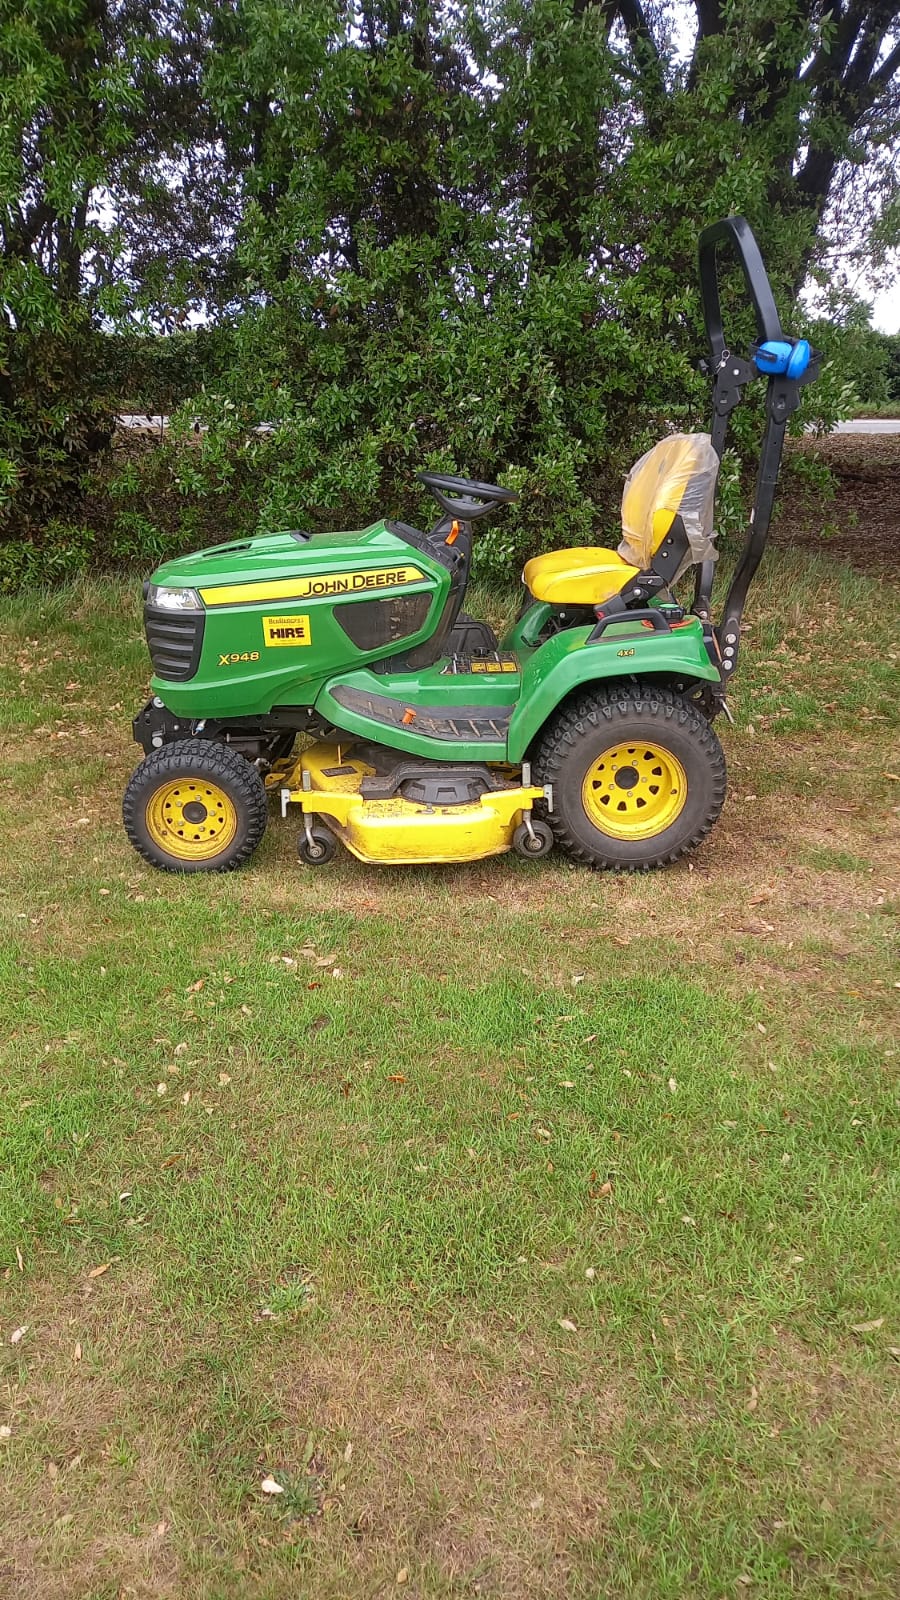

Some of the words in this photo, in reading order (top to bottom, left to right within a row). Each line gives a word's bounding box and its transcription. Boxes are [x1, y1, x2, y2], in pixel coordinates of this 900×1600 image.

[303, 578, 348, 596] JOHN
[352, 571, 407, 589] DEERE
[270, 627, 305, 639] HIRE
[217, 651, 260, 666] X948
